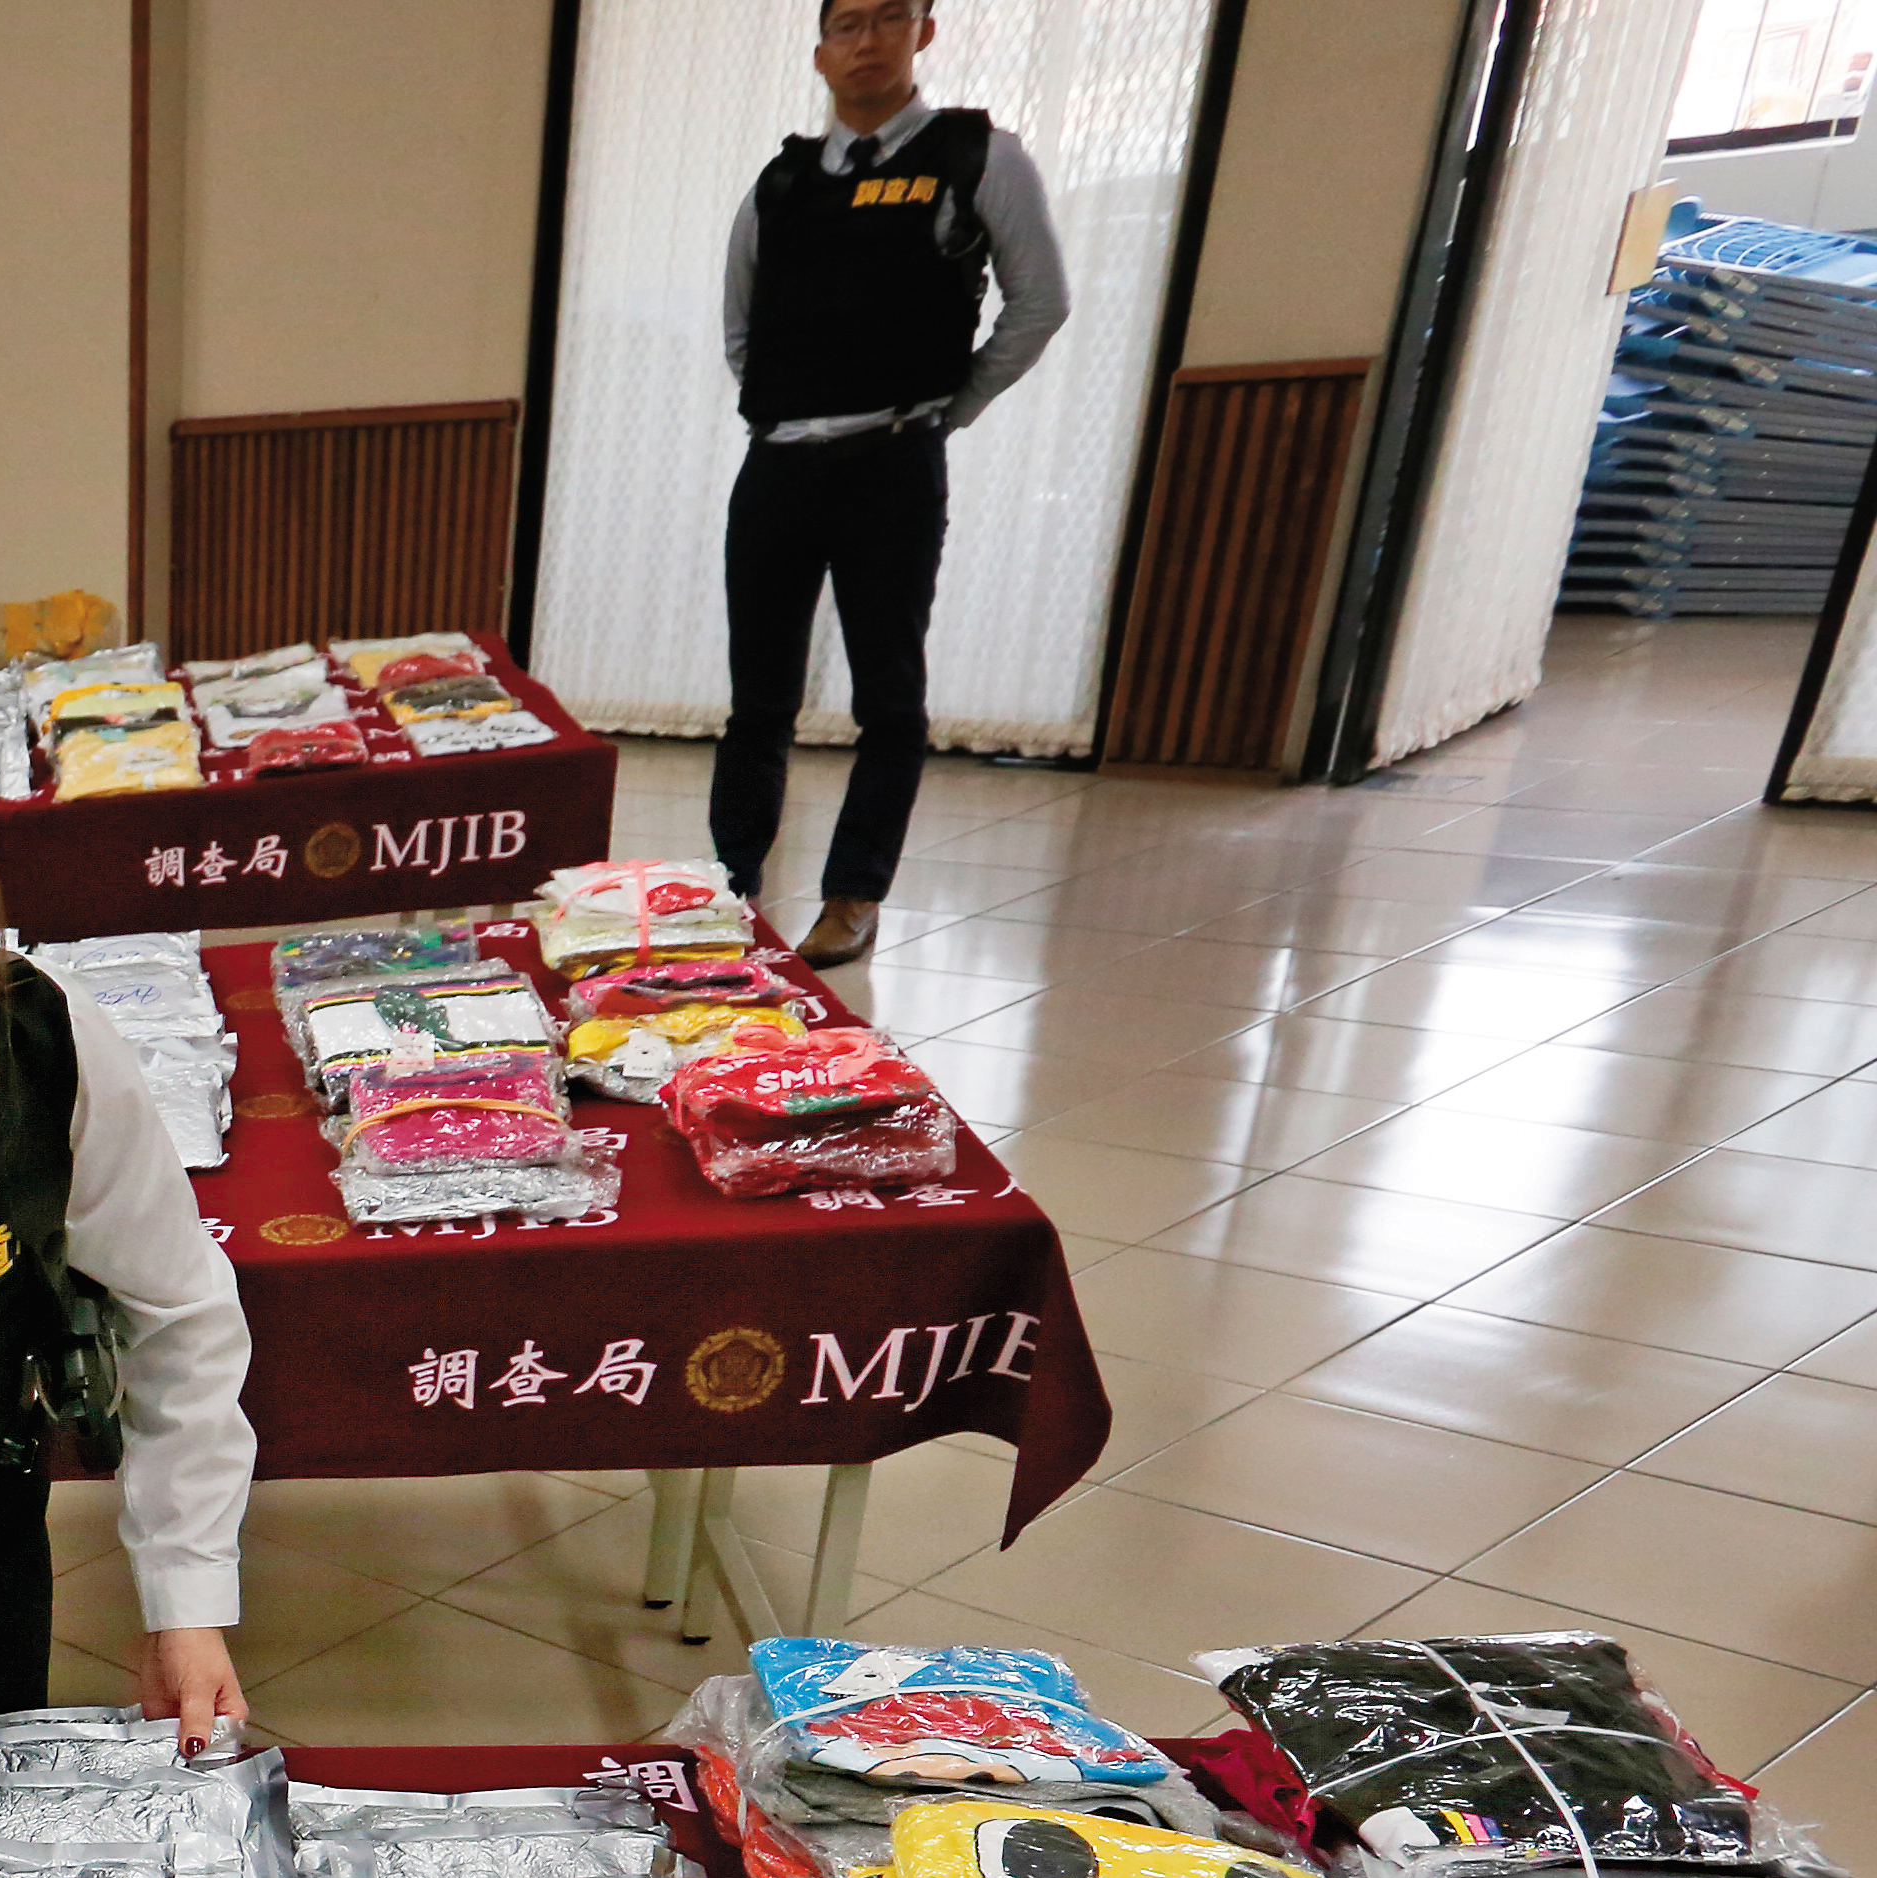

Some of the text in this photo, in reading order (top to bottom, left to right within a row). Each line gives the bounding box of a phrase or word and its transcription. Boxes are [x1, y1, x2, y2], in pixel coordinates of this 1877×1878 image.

[146, 835, 289, 888] 調查局
[371, 811, 526, 875] MJIB
[408, 1338, 658, 1409] 調查局
